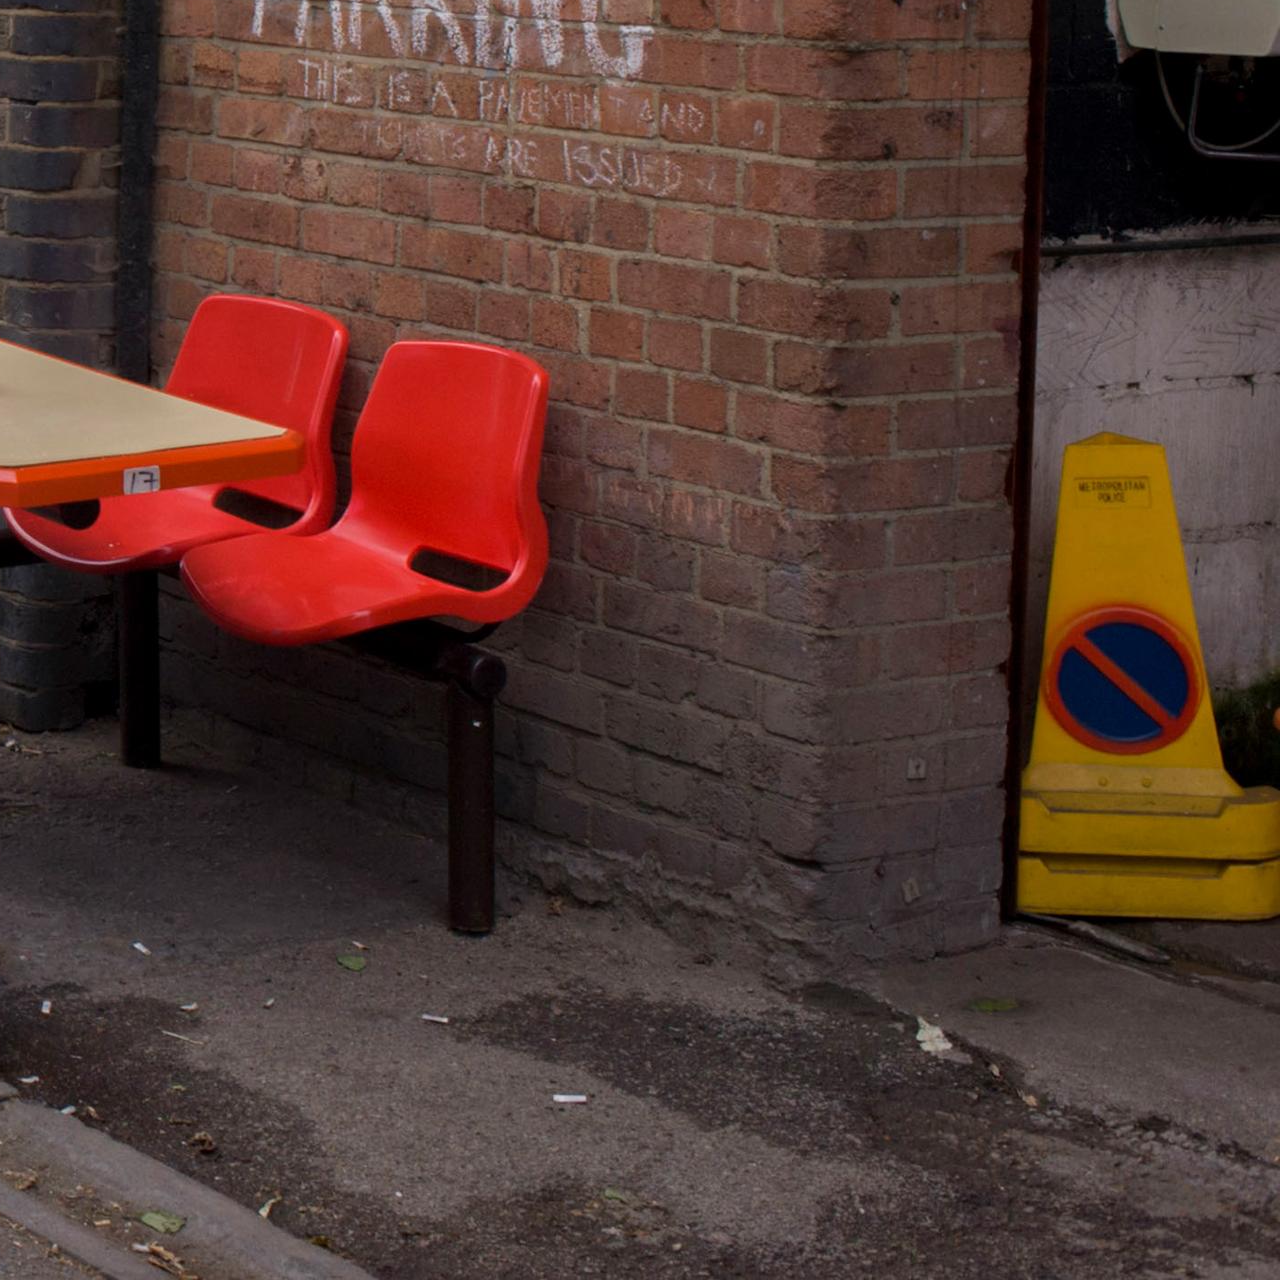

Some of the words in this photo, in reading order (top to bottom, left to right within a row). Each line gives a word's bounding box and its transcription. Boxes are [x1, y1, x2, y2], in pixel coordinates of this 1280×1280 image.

[298, 58, 362, 107] THIS
[387, 71, 412, 108] IS
[484, 132, 538, 176] ARE
[562, 138, 684, 198] ISSUED
[130, 470, 159, 495] 17
[1078, 481, 1145, 492] METROPOLITAN
[1097, 492, 1126, 503] POLICE
